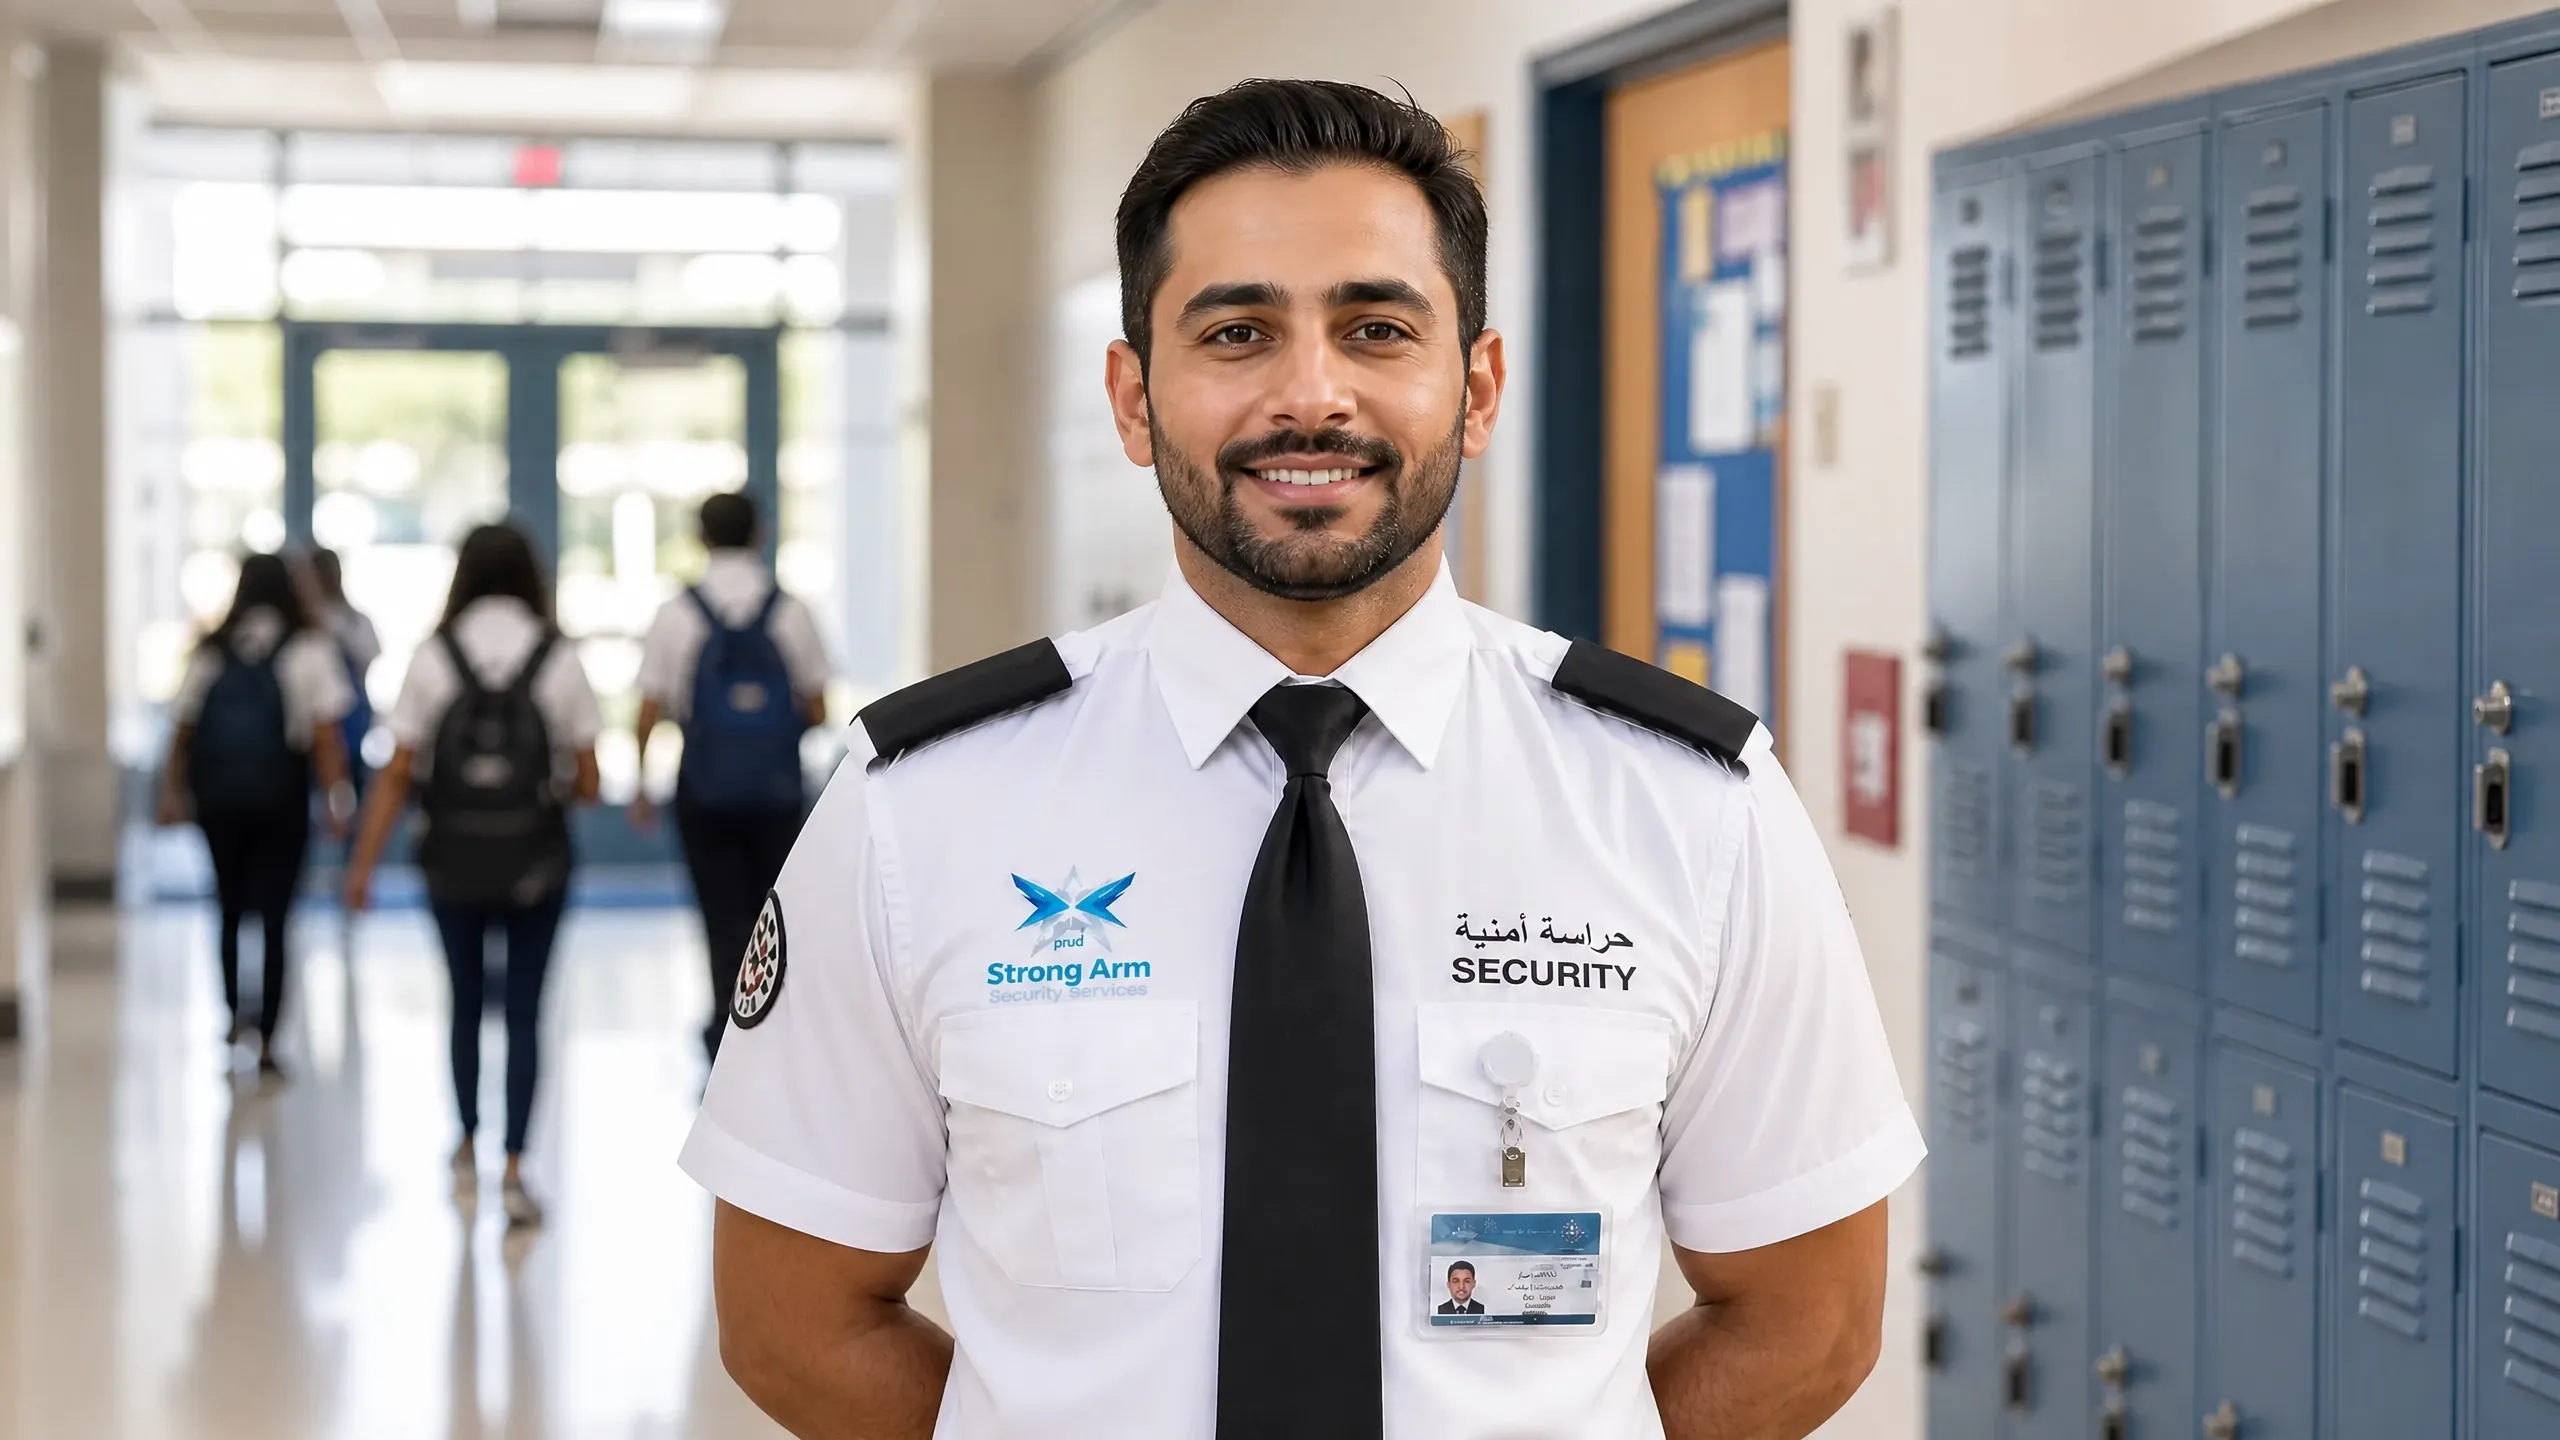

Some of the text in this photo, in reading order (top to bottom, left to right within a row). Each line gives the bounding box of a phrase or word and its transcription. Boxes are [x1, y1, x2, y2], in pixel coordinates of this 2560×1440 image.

[1054, 934, 1084, 951] prud
[1455, 912, 1634, 954] حراسة أمنية
[988, 958, 1150, 987] Strong Arm
[1452, 957, 1637, 991] SECURITY
[989, 986, 1062, 1004] Security
